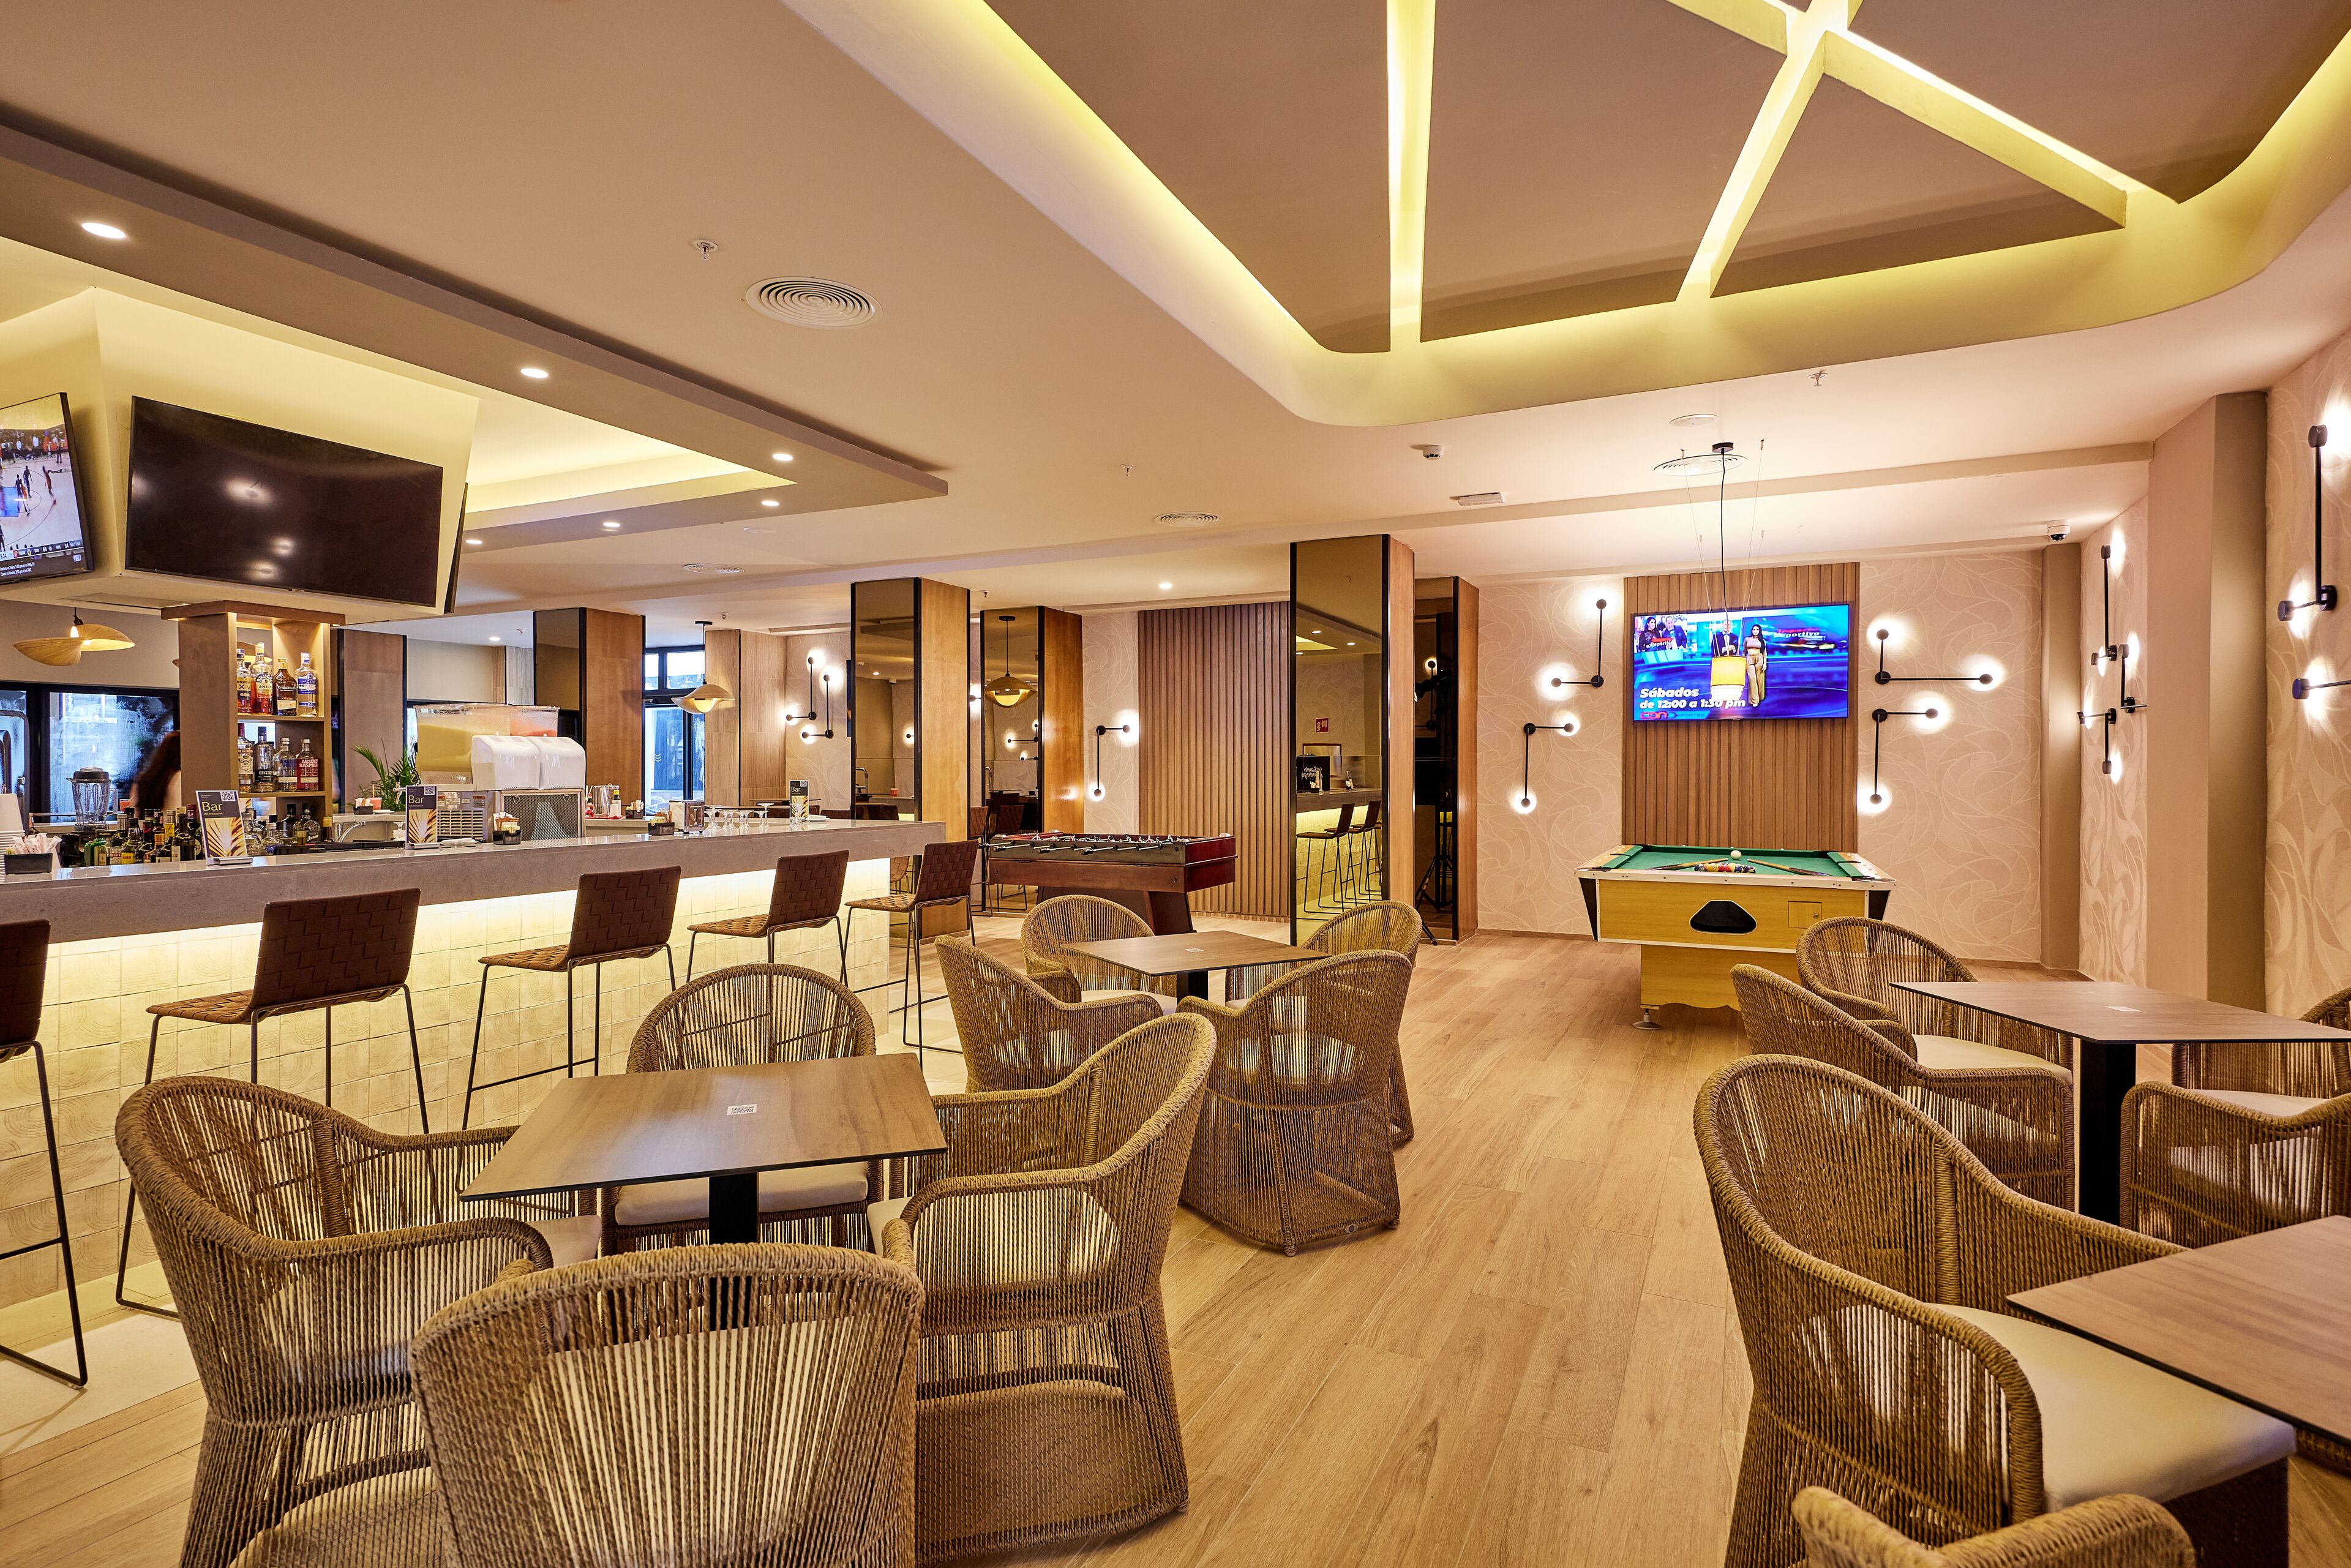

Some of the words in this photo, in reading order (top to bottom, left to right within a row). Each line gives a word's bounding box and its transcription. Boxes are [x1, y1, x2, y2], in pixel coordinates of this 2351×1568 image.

[1640, 687, 1699, 698] Sábados
[1657, 700, 1687, 708] 12:00
[1700, 699, 1723, 708] 1:30
[1725, 700, 1745, 709] pm
[408, 795, 425, 804] Bar
[202, 801, 223, 811] Bar
